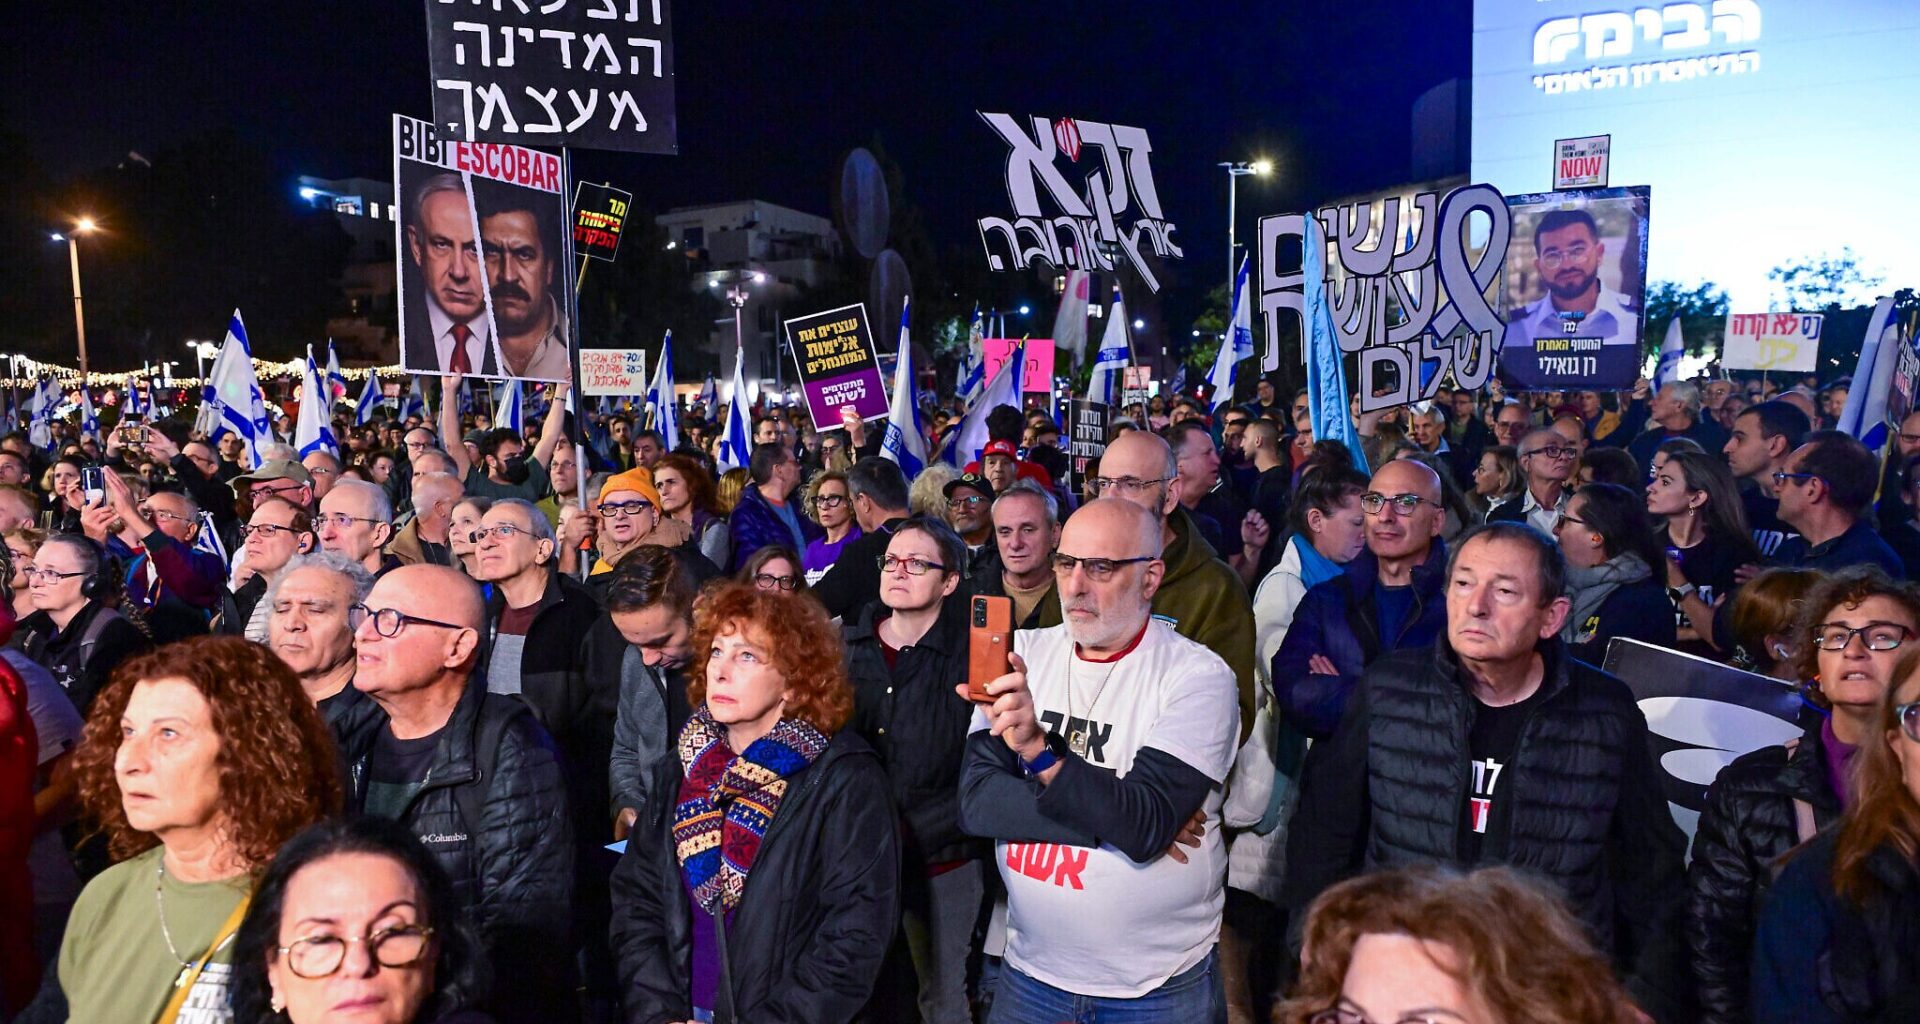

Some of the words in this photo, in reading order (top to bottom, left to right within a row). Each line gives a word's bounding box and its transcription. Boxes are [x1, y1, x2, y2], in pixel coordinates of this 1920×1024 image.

[453, 21, 662, 77] המדינה
[1533, 66, 1628, 95] הלאומי
[1631, 50, 1760, 88] התיאטרון
[437, 79, 648, 142] מעצמך
[399, 116, 448, 166] BIBI
[456, 141, 561, 193] ESCOBAR
[1560, 156, 1601, 179] NOW
[609, 198, 626, 216] מר
[574, 225, 618, 250] הפקרה
[977, 216, 1115, 272] אהובה
[1258, 190, 1440, 295] נשים
[1116, 218, 1184, 294] ארץ
[798, 328, 817, 342] את
[817, 318, 858, 338] עוצרים
[1732, 314, 1768, 341] קרה
[1772, 314, 1799, 336] לא
[1802, 316, 1821, 340] נס
[806, 335, 860, 358] אלימות
[1536, 340, 1569, 352] האחרון
[1570, 339, 1601, 352] החטוף
[806, 349, 867, 374] המתנחלים
[1358, 329, 1492, 413] שלום
[1539, 356, 1579, 375] גואילי
[1583, 356, 1597, 376] רן
[821, 379, 865, 395] מתקדמים
[824, 387, 866, 406] לשלום
[1076, 424, 1103, 441] חקירה
[427, 832, 468, 843] Columbia
[1006, 841, 1089, 890] אשם
